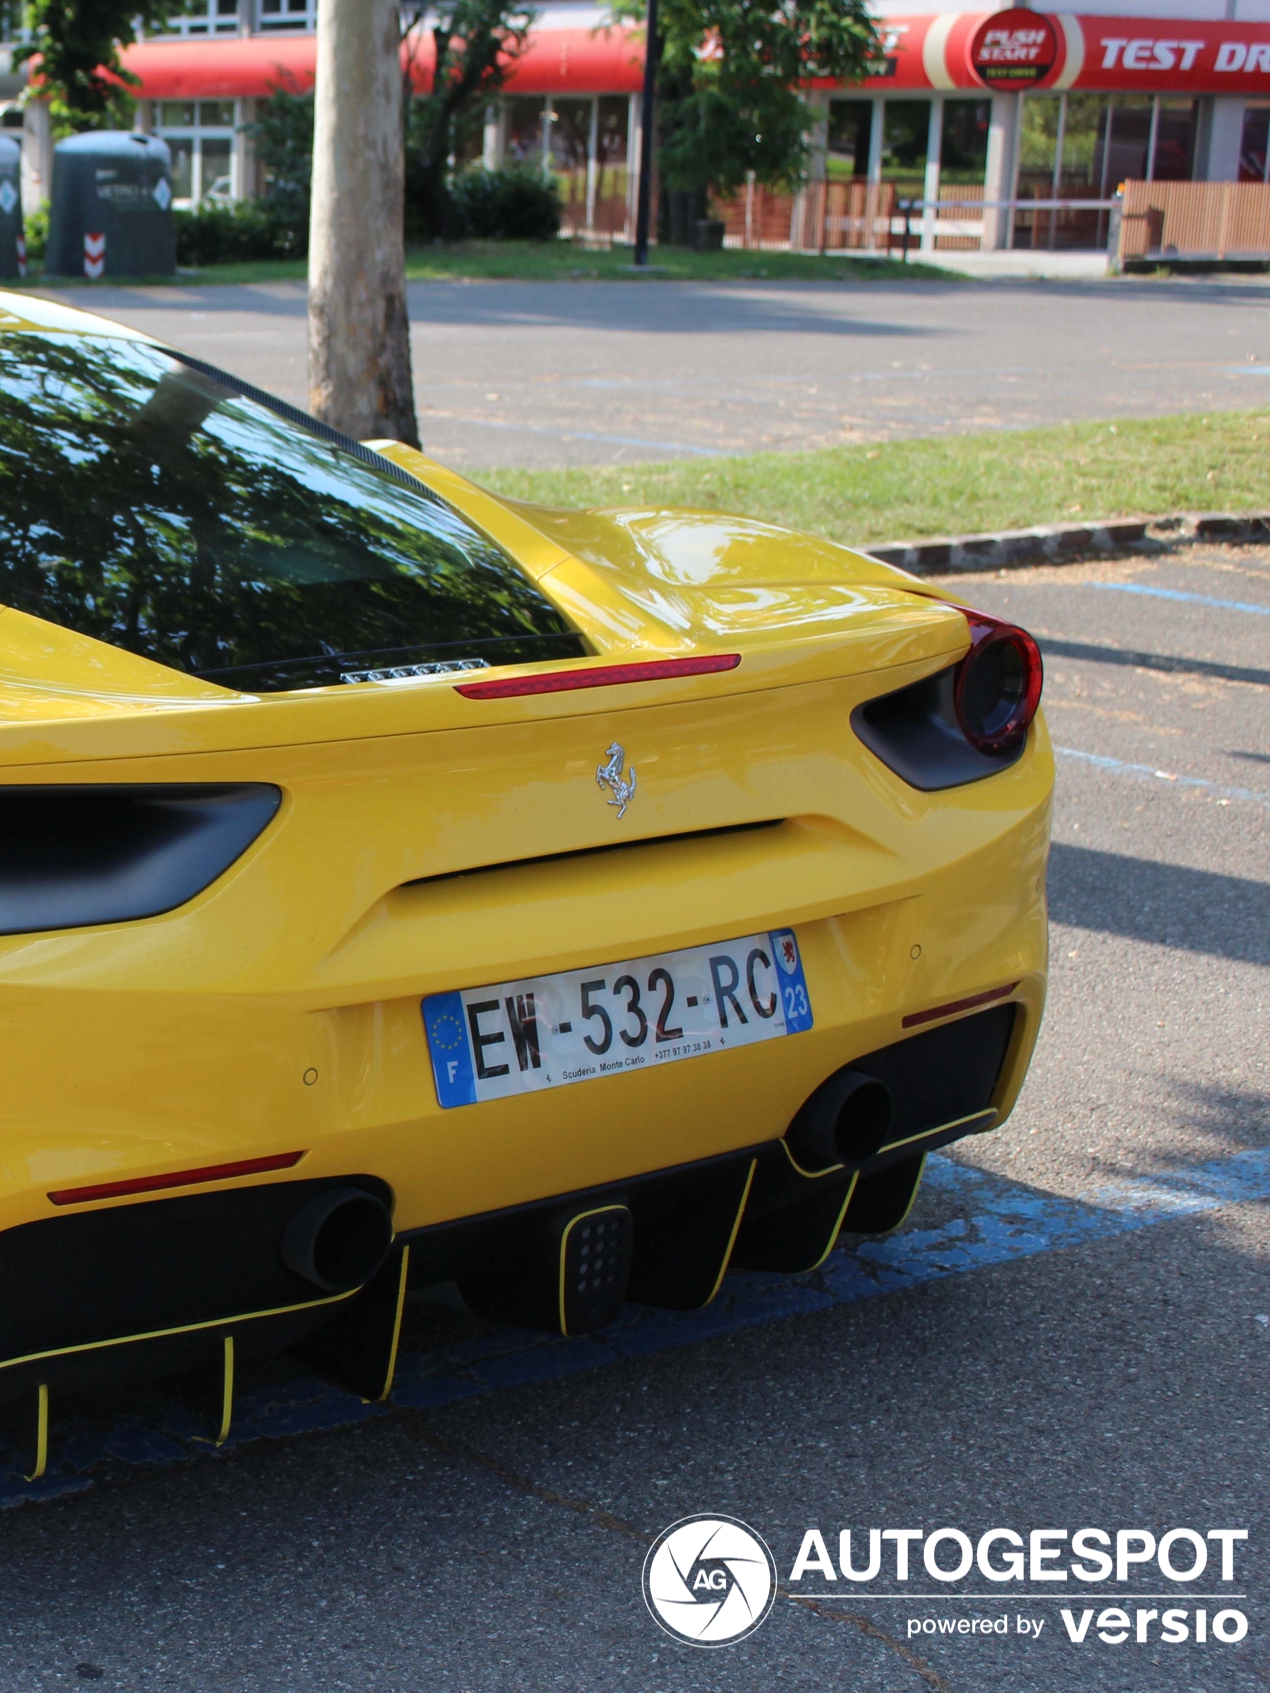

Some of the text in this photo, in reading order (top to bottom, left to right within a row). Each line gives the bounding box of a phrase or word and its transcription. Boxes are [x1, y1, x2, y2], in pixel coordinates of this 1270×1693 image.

[978, 46, 1040, 61] START
[984, 29, 1046, 46] PUSH
[1100, 38, 1205, 71] TEST
[447, 948, 808, 1083] F EW-532-RC 23
[562, 1041, 711, 1080] Scuderia Monte Carlo +377 97 97 38 38
